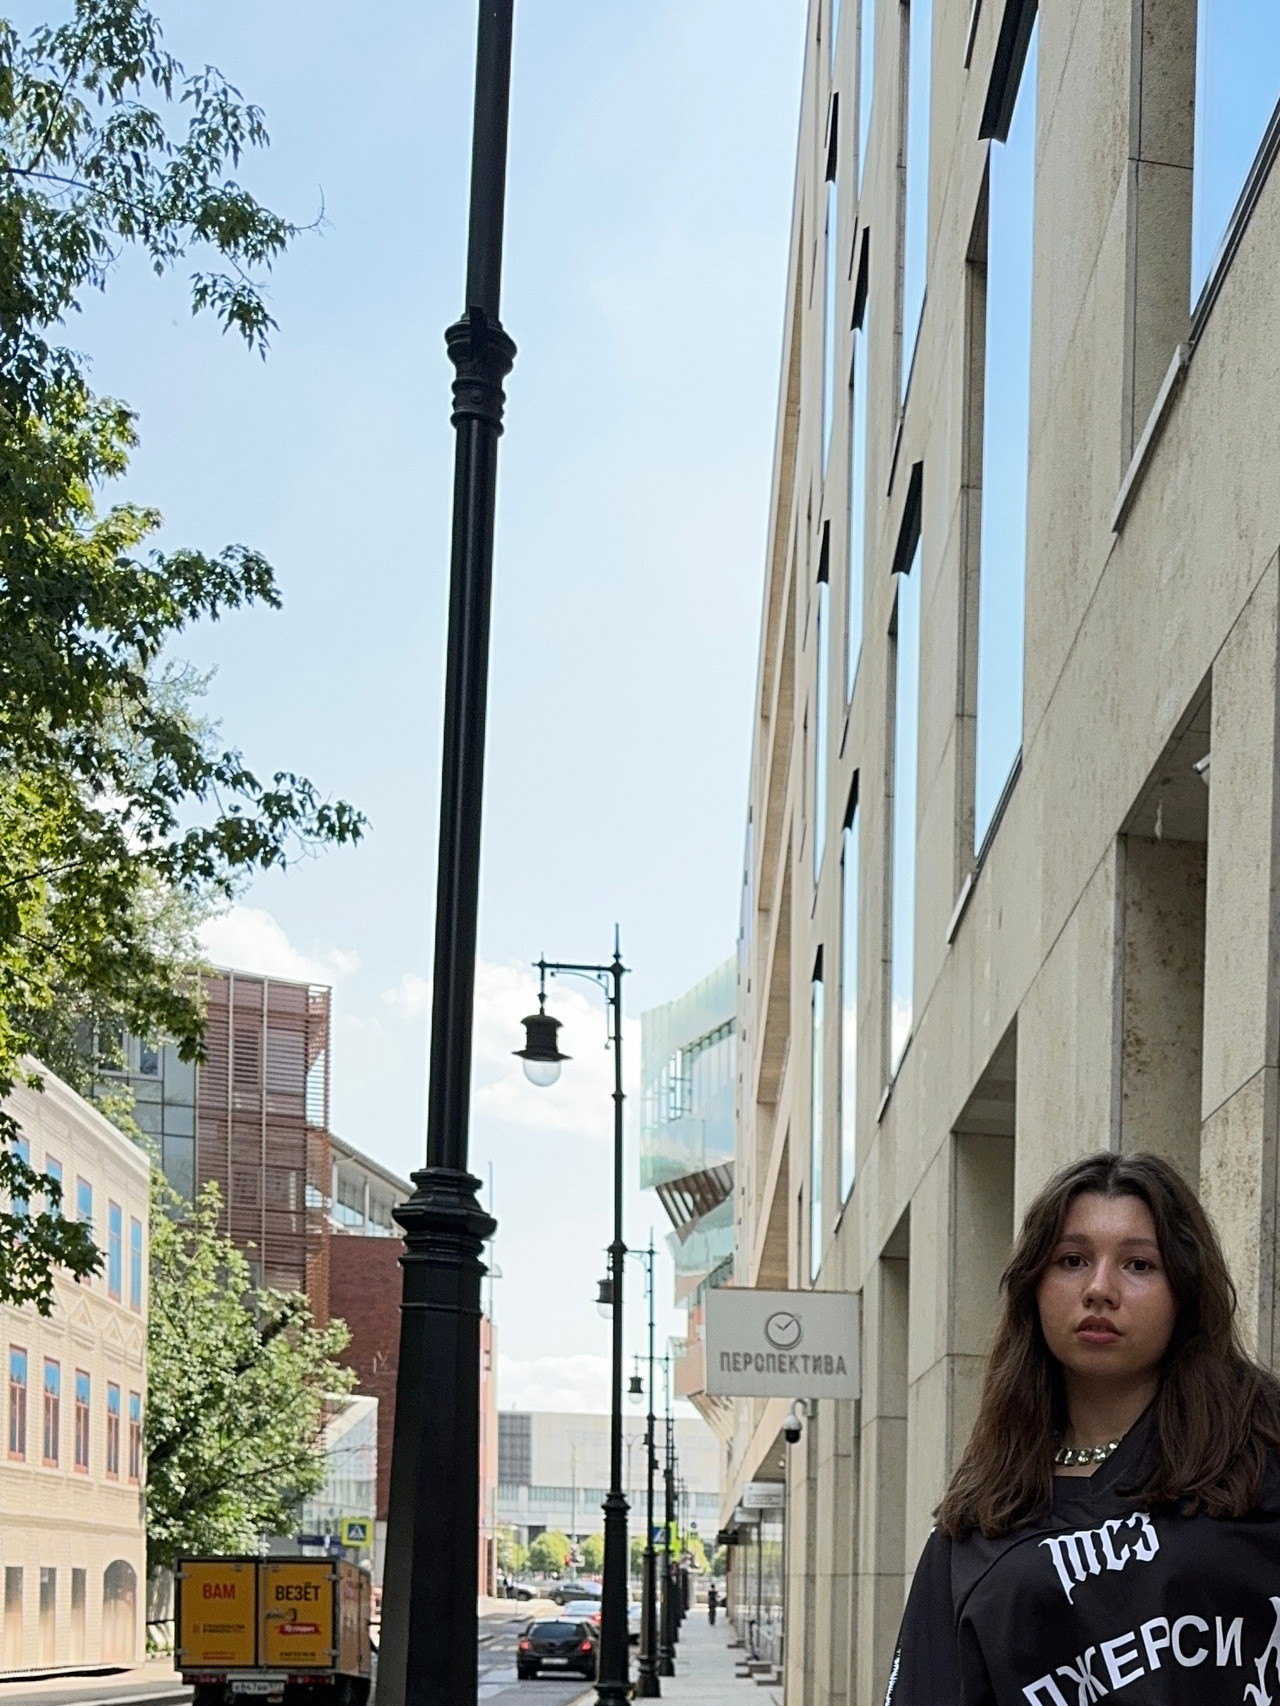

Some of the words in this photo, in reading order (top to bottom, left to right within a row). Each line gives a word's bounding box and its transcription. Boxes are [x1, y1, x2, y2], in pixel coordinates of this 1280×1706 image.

[720, 1351, 848, 1376] ПЕРСПЕКТИВА
[203, 1583, 236, 1600] ВАМ
[275, 1581, 321, 1602] ВЕЗЁТ
